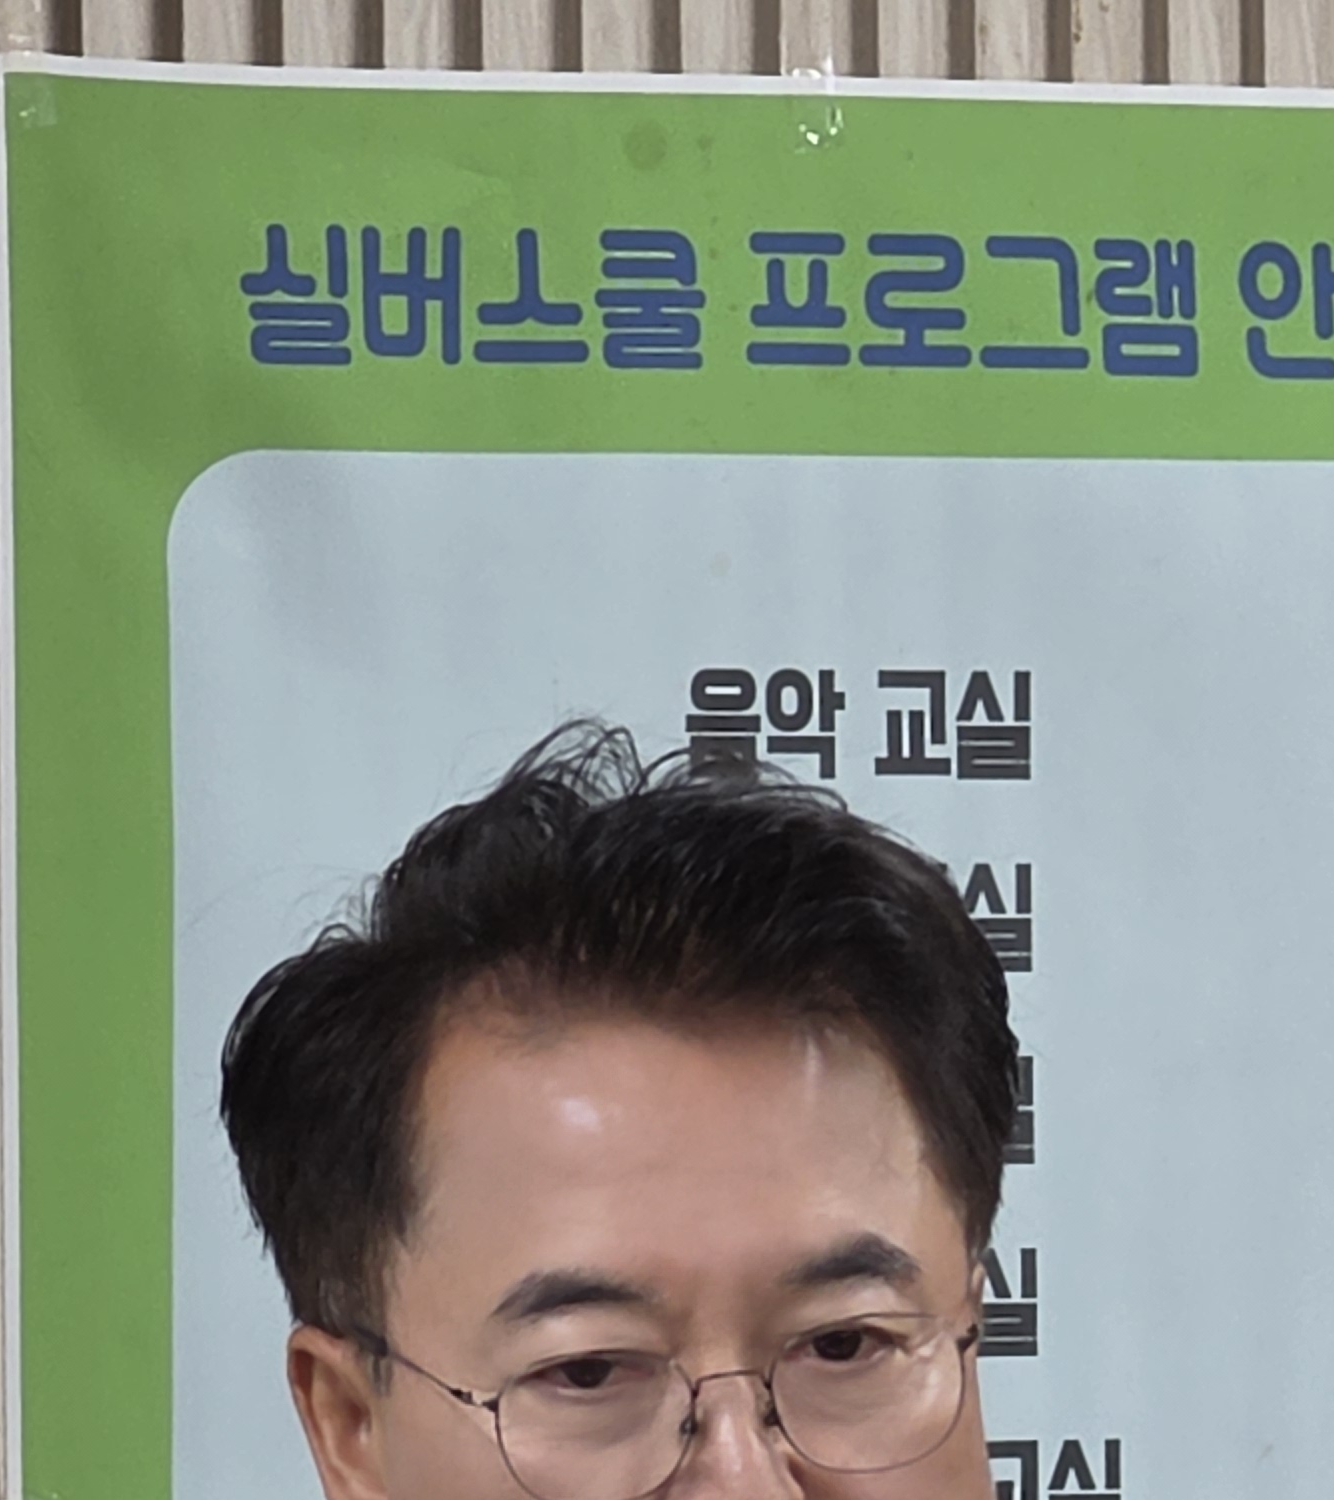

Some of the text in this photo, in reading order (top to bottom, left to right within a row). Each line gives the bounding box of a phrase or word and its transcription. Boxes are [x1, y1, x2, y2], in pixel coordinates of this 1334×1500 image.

[240, 223, 705, 369] 실버스쿨
[747, 230, 1200, 378] 프로그램
[685, 668, 1031, 786] 음악 교실
[963, 863, 1032, 972] 실
[977, 1248, 1038, 1356] 실
